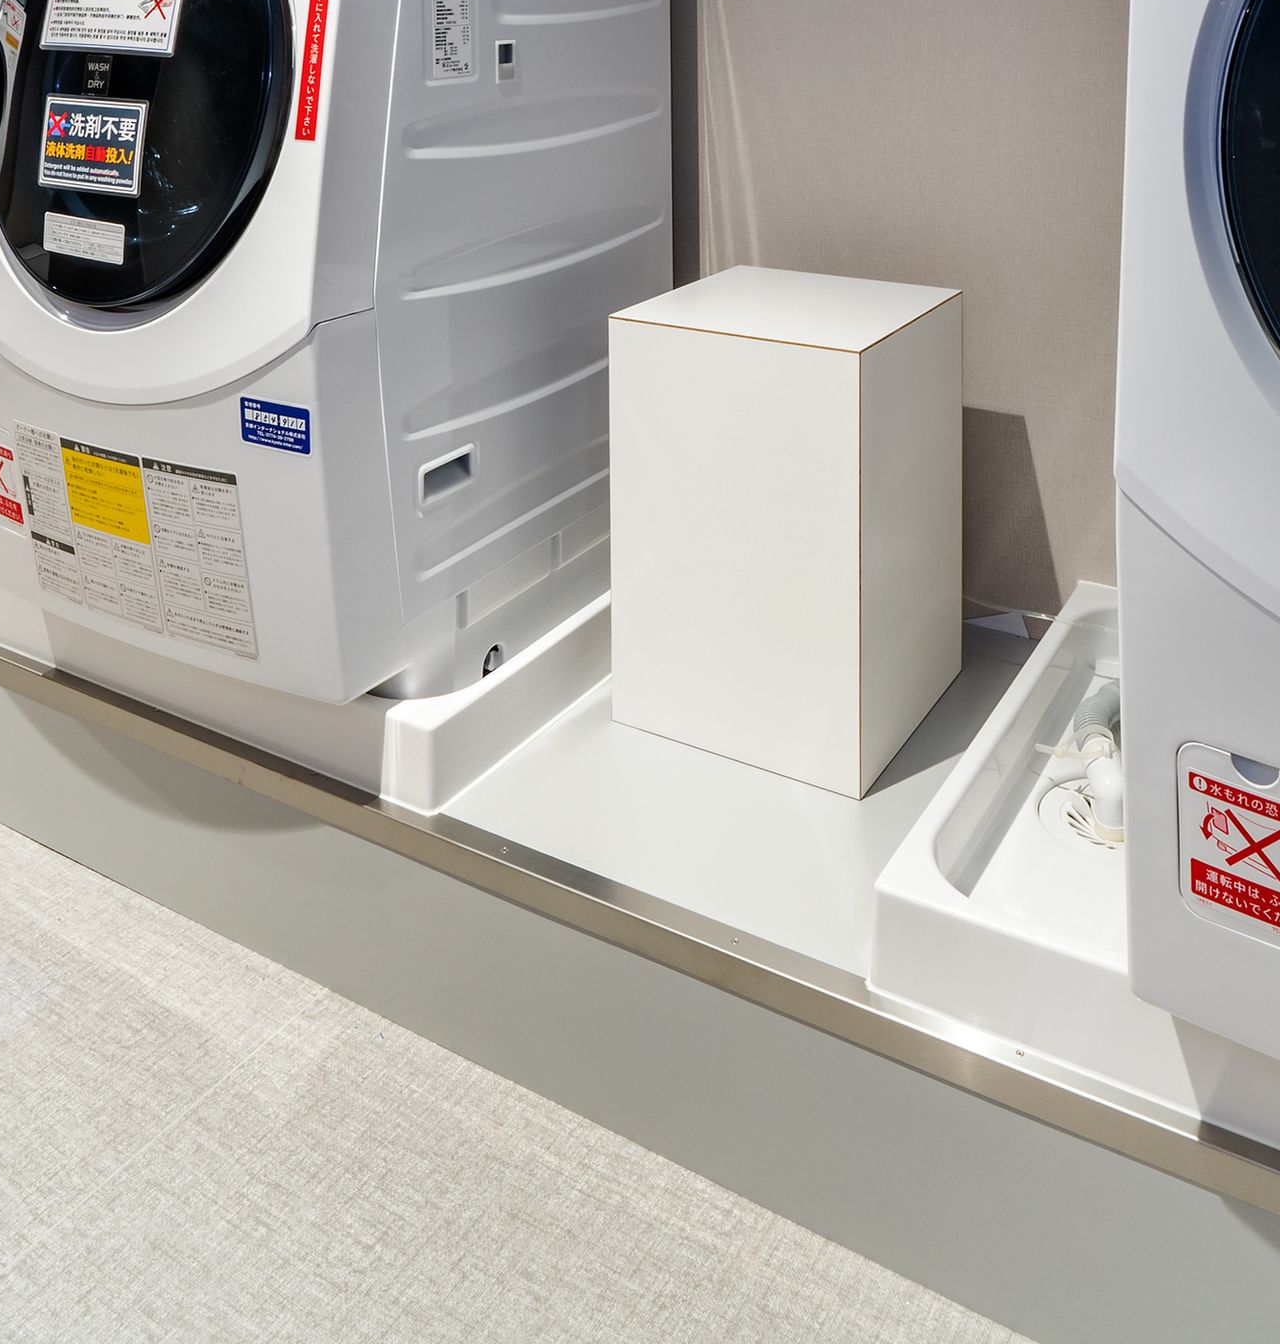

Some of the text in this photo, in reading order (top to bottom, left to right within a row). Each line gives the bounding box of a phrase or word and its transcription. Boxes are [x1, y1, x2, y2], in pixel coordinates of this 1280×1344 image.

[87, 62, 110, 72] WASH
[87, 79, 105, 89] DRY
[69, 113, 138, 143] 洗剤不要
[46, 140, 133, 166] 液体洗剤自動投入!
